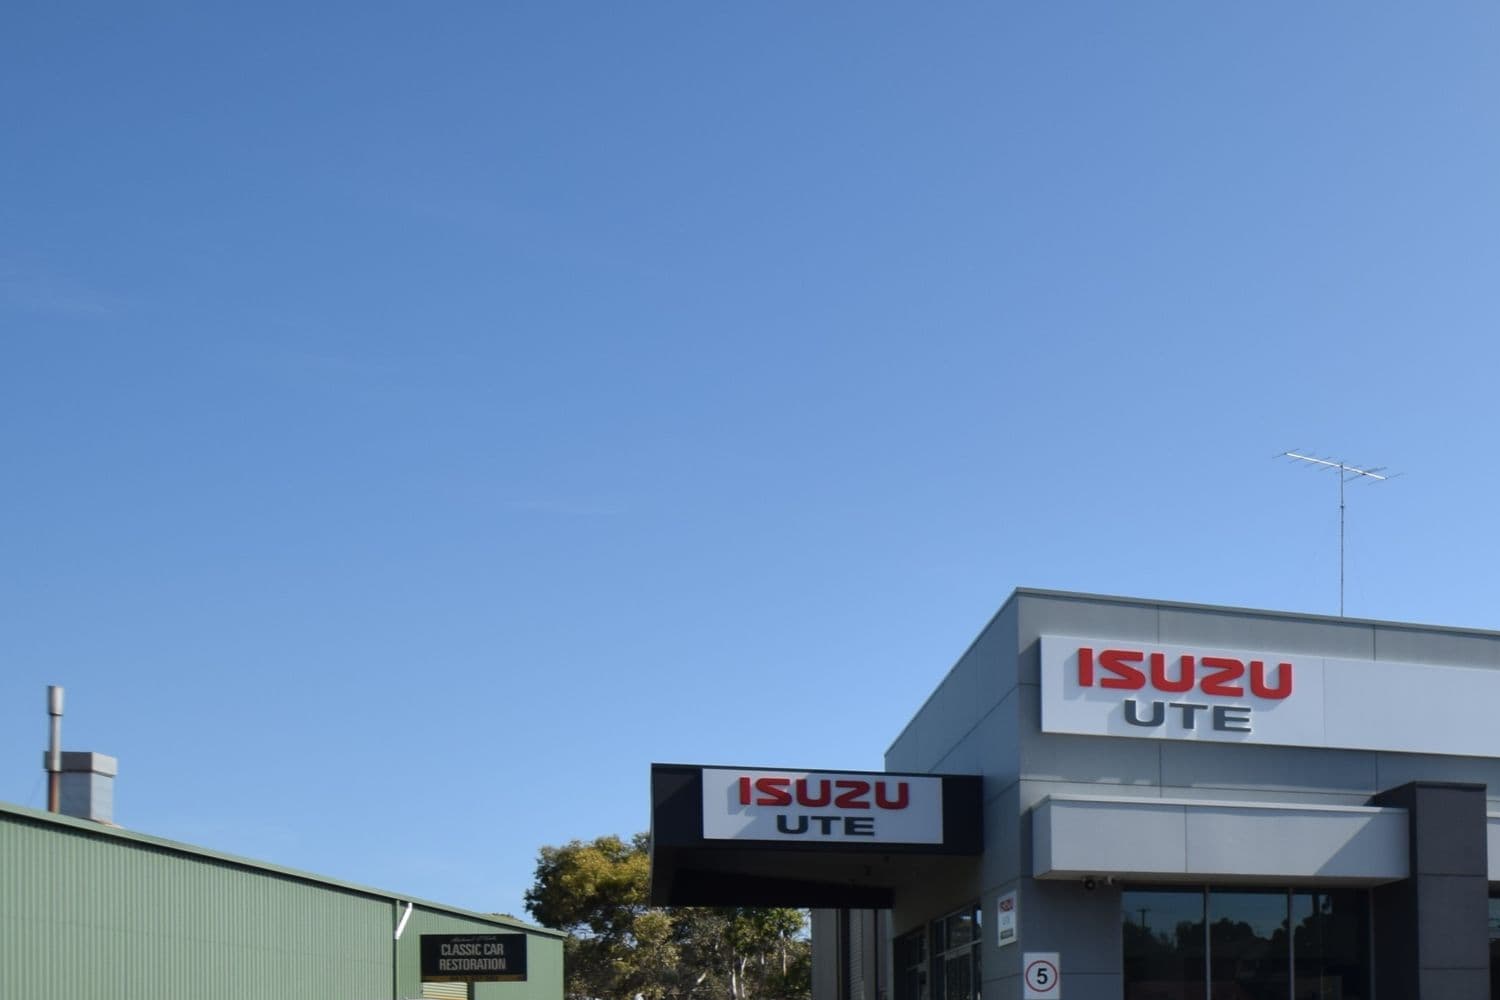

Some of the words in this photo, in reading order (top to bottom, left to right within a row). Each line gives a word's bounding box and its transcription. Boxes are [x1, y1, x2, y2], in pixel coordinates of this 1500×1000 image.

[1078, 647, 1293, 700] ISUZU
[1124, 699, 1252, 733] UTE
[739, 776, 909, 810] ISUZU
[776, 814, 876, 837] UTE
[441, 943, 482, 956] CLASSIC
[483, 943, 504, 956] CAR
[439, 958, 507, 971] RESTORATION
[1036, 967, 1049, 985] 5
